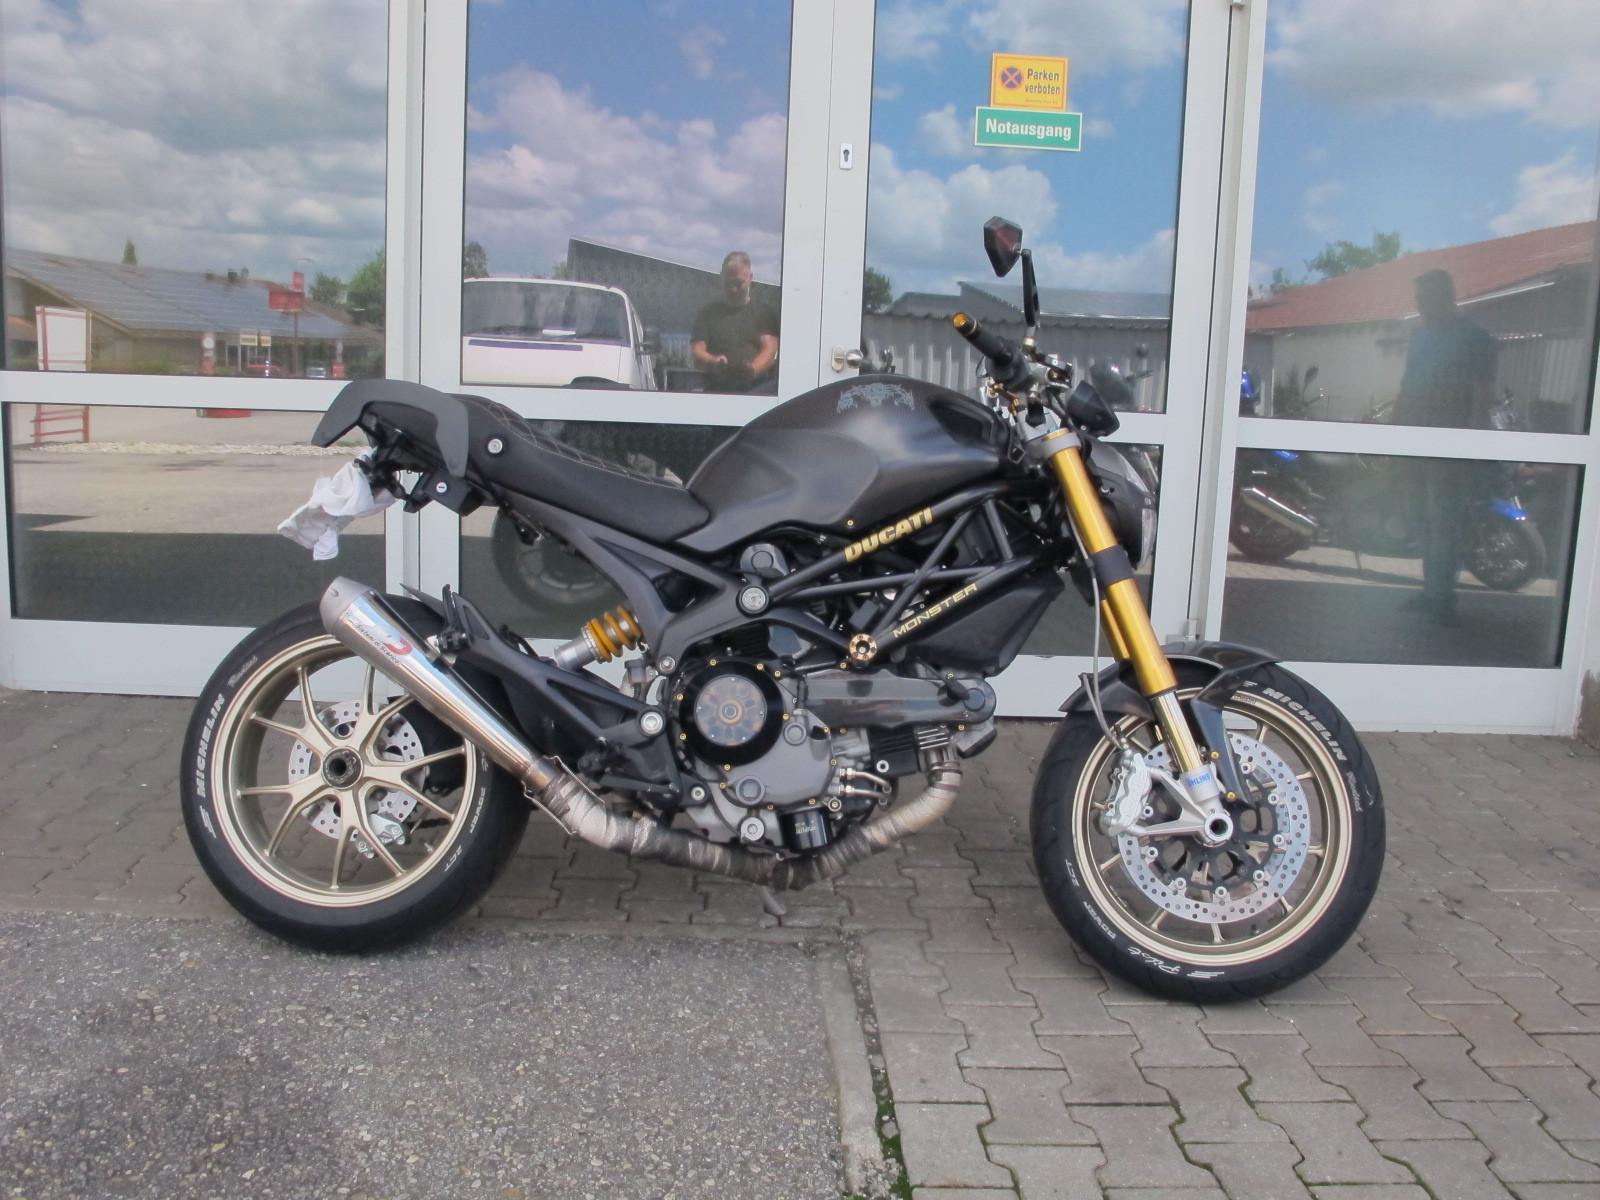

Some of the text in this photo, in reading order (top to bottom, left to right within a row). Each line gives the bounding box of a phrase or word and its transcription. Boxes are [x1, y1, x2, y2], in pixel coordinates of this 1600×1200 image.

[1024, 83, 1061, 95] verboten
[1027, 68, 1060, 81] Parken
[985, 117, 1072, 141] Notausgang
[844, 506, 934, 562] DUCATI
[892, 583, 978, 638] MONSTER
[1262, 687, 1347, 761] MICHELIN
[196, 693, 225, 798] MICHELIN
[1127, 946, 1182, 975] Pilot
